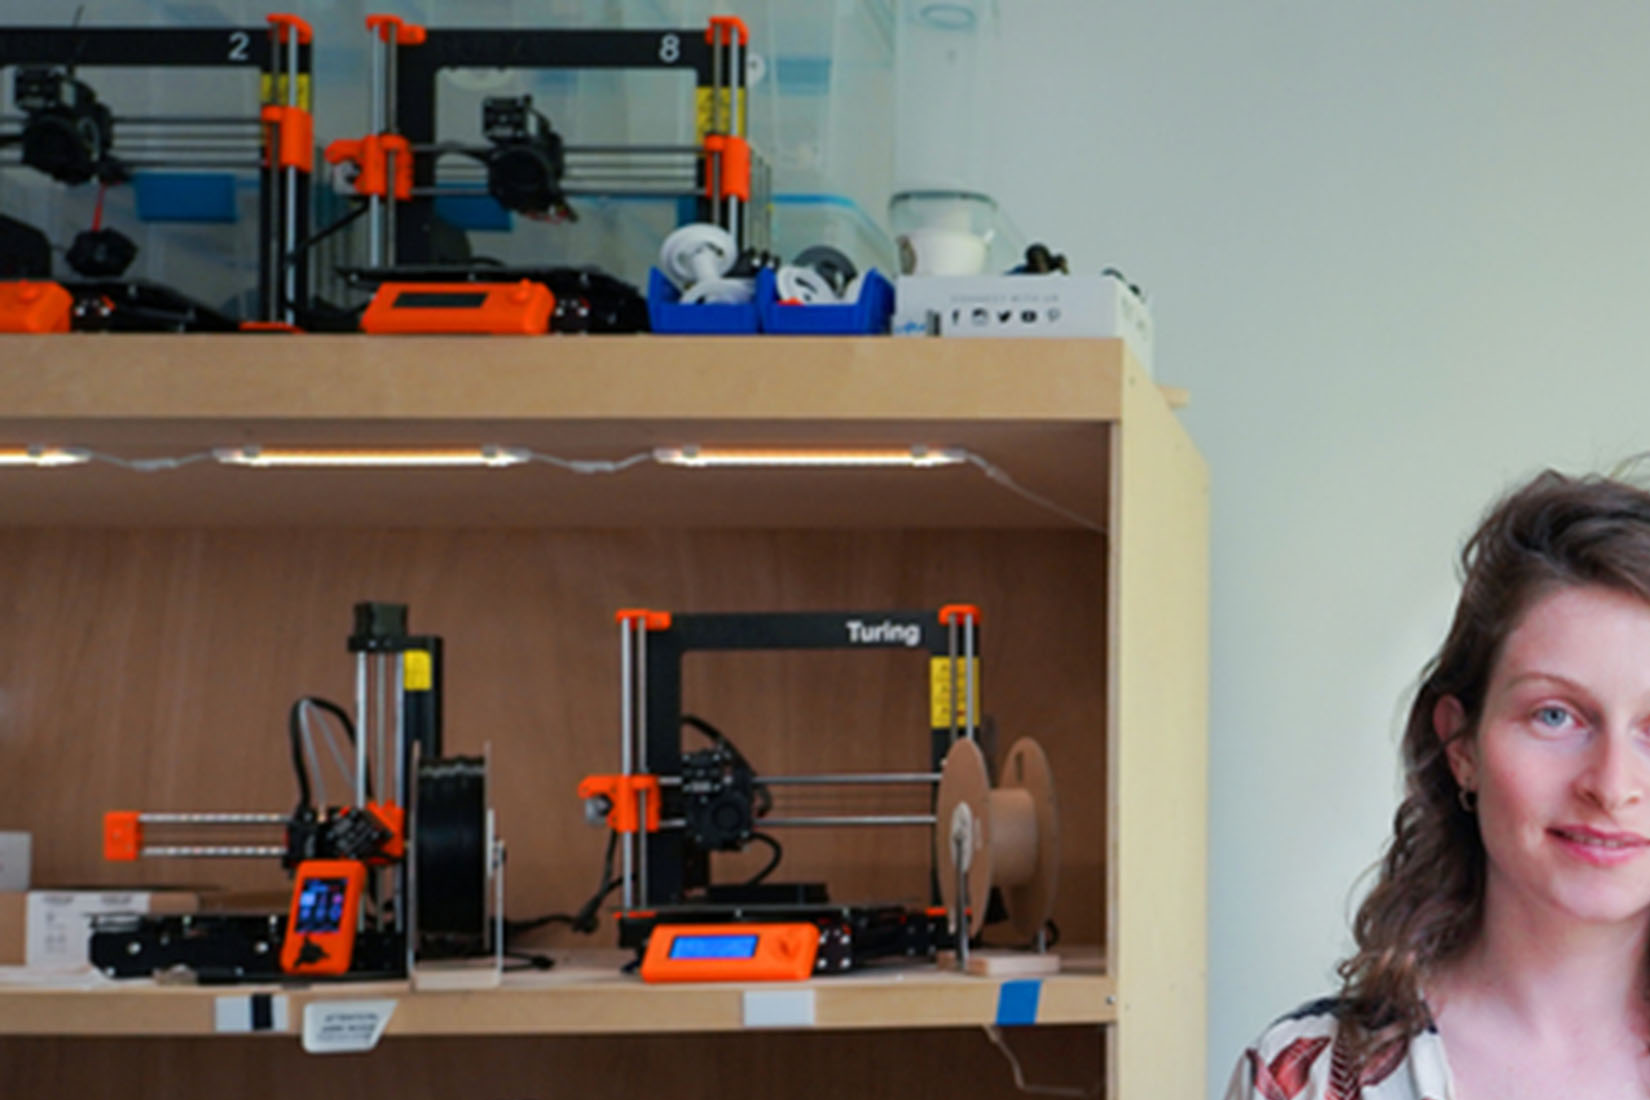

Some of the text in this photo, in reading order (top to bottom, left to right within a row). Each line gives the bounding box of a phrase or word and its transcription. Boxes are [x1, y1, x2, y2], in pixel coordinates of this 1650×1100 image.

[229, 32, 249, 60] 2
[659, 34, 680, 63] 8
[846, 620, 920, 646] Turing
